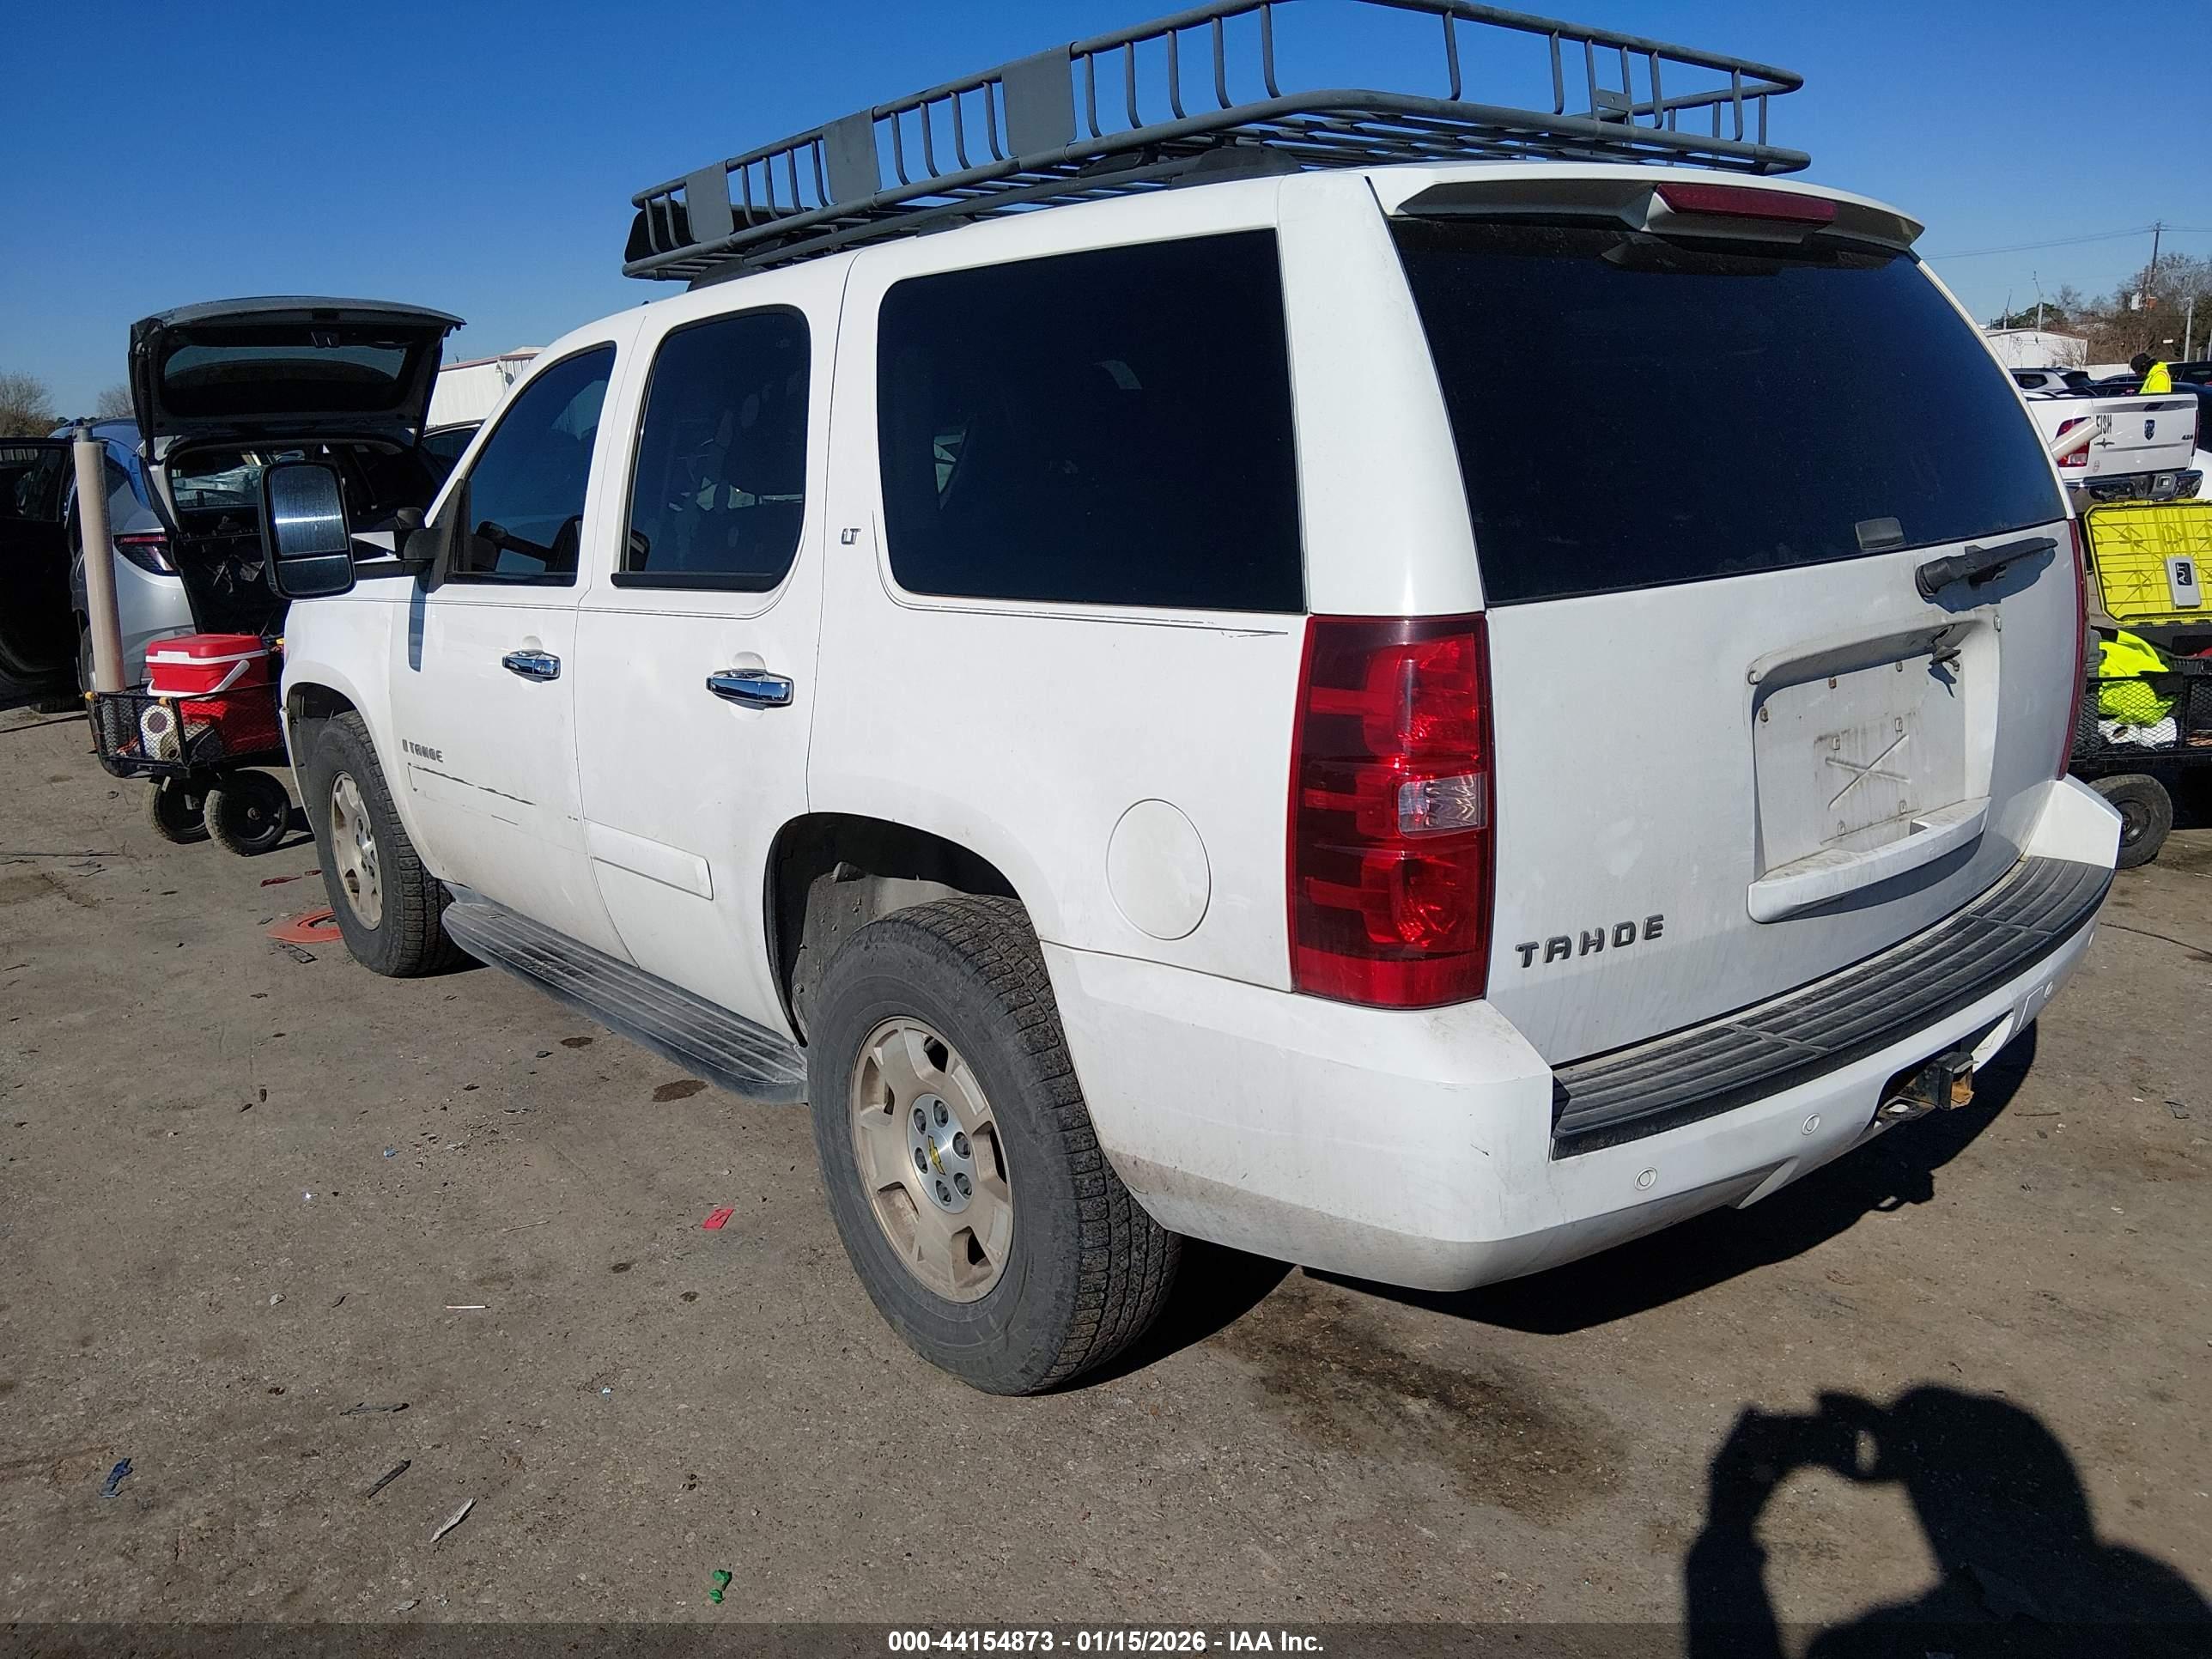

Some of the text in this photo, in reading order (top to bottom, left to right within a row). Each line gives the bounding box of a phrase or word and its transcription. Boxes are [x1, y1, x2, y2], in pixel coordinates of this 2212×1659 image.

[842, 528, 861, 545] LT
[409, 741, 444, 763] TAHOE
[1515, 914, 1664, 969] TAHOE
